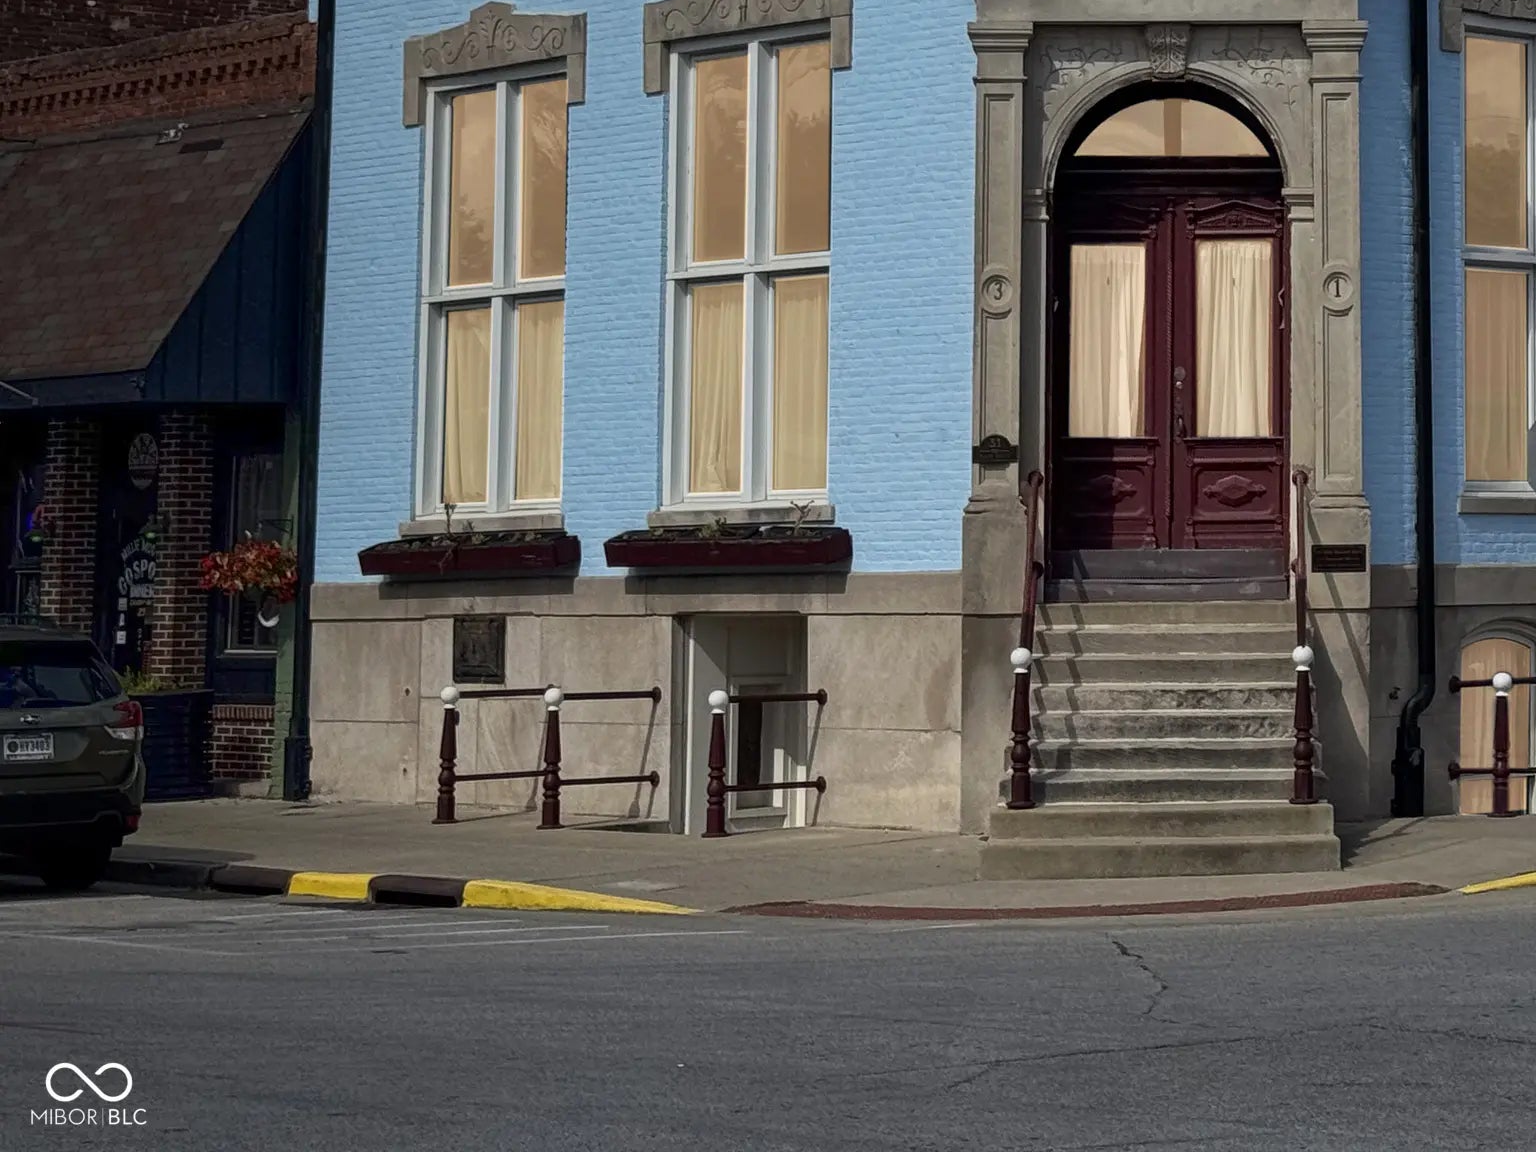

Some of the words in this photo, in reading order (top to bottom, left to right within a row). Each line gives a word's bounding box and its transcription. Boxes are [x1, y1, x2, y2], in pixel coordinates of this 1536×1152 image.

[993, 281, 1003, 301] 3
[1333, 277, 1342, 298] 1
[118, 559, 156, 595] GOSPO
